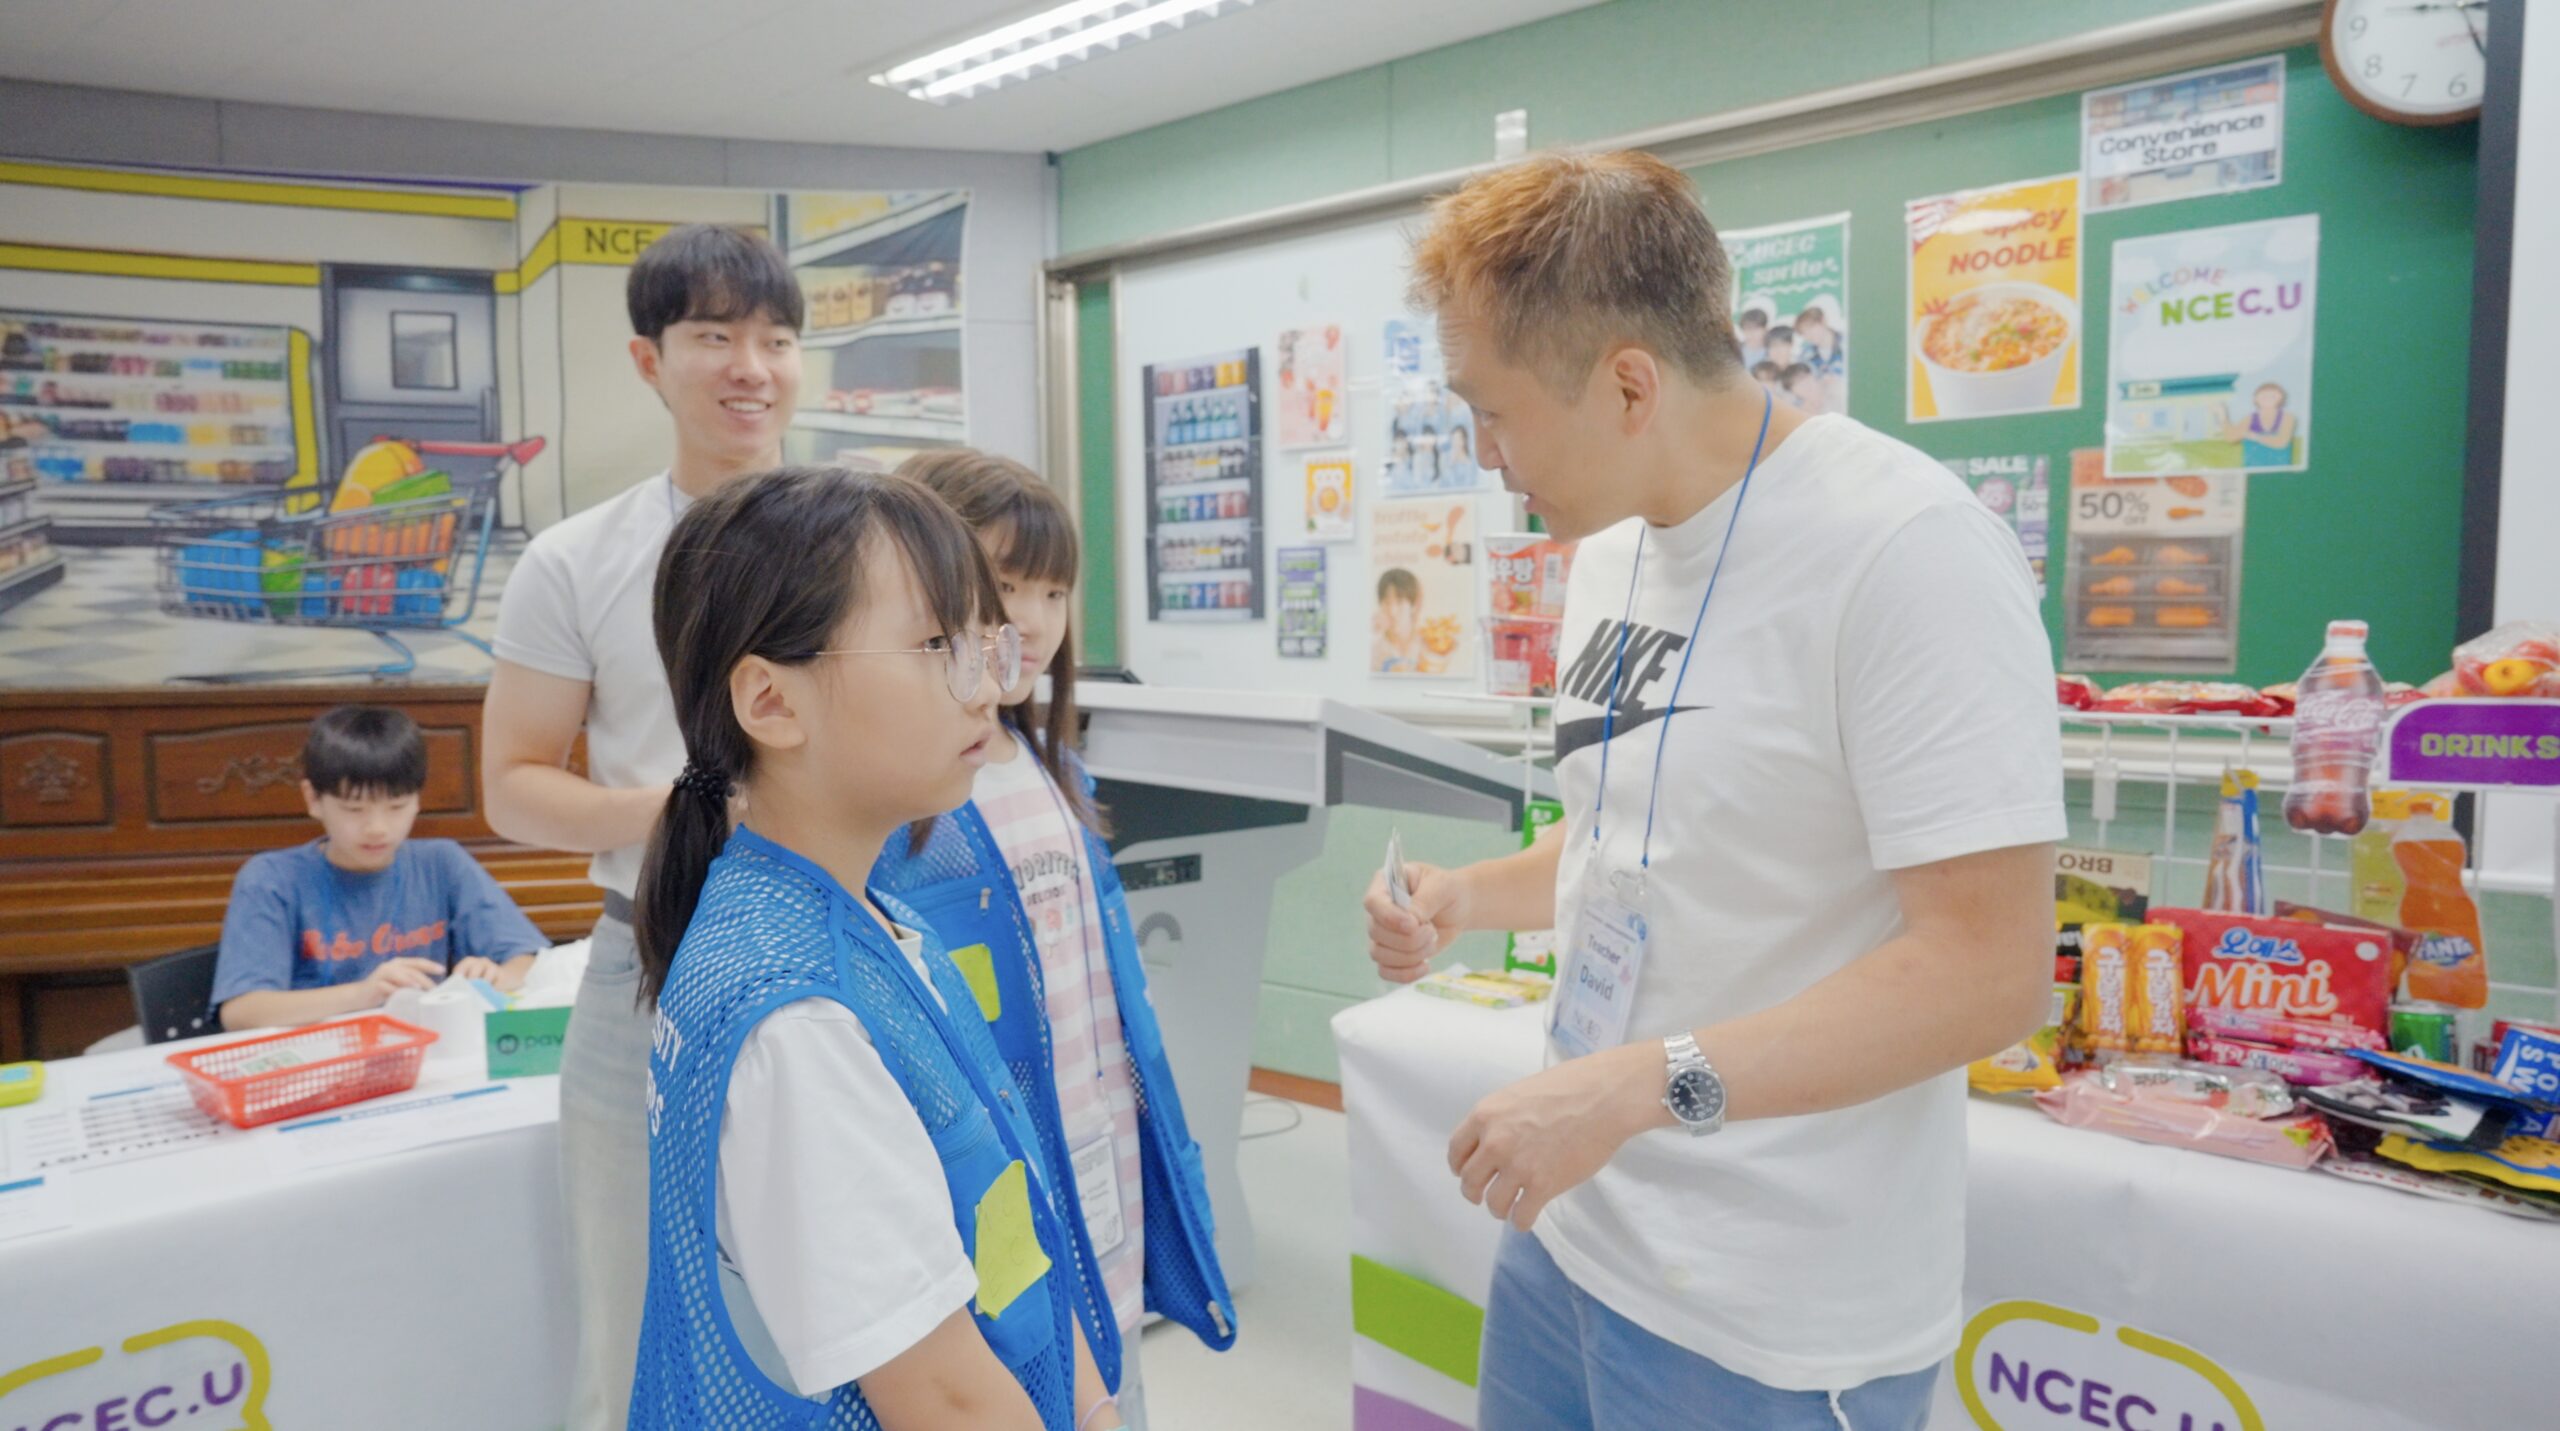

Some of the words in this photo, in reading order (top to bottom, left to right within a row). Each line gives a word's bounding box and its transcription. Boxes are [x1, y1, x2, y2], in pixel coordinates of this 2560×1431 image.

[2350, 15, 2367, 40] 9
[2364, 55, 2381, 78] 8
[2400, 74, 2417, 97] 7
[2448, 74, 2467, 98] 6
[2100, 114, 2264, 155] Convenience
[2143, 141, 2217, 165] Store
[1948, 236, 2075, 275] NOODLE
[2161, 282, 2302, 326] NCEC.U
[1968, 455, 2029, 475] SALE
[2079, 491, 2149, 520] 50%
[1560, 617, 1689, 713] NIKE
[2420, 732, 2560, 759] DRINKS
[1588, 933, 1621, 965] Teacher
[1580, 964, 1614, 1001] David
[2190, 962, 2339, 1016] Mini
[1989, 1352, 2225, 1431] NCEC
